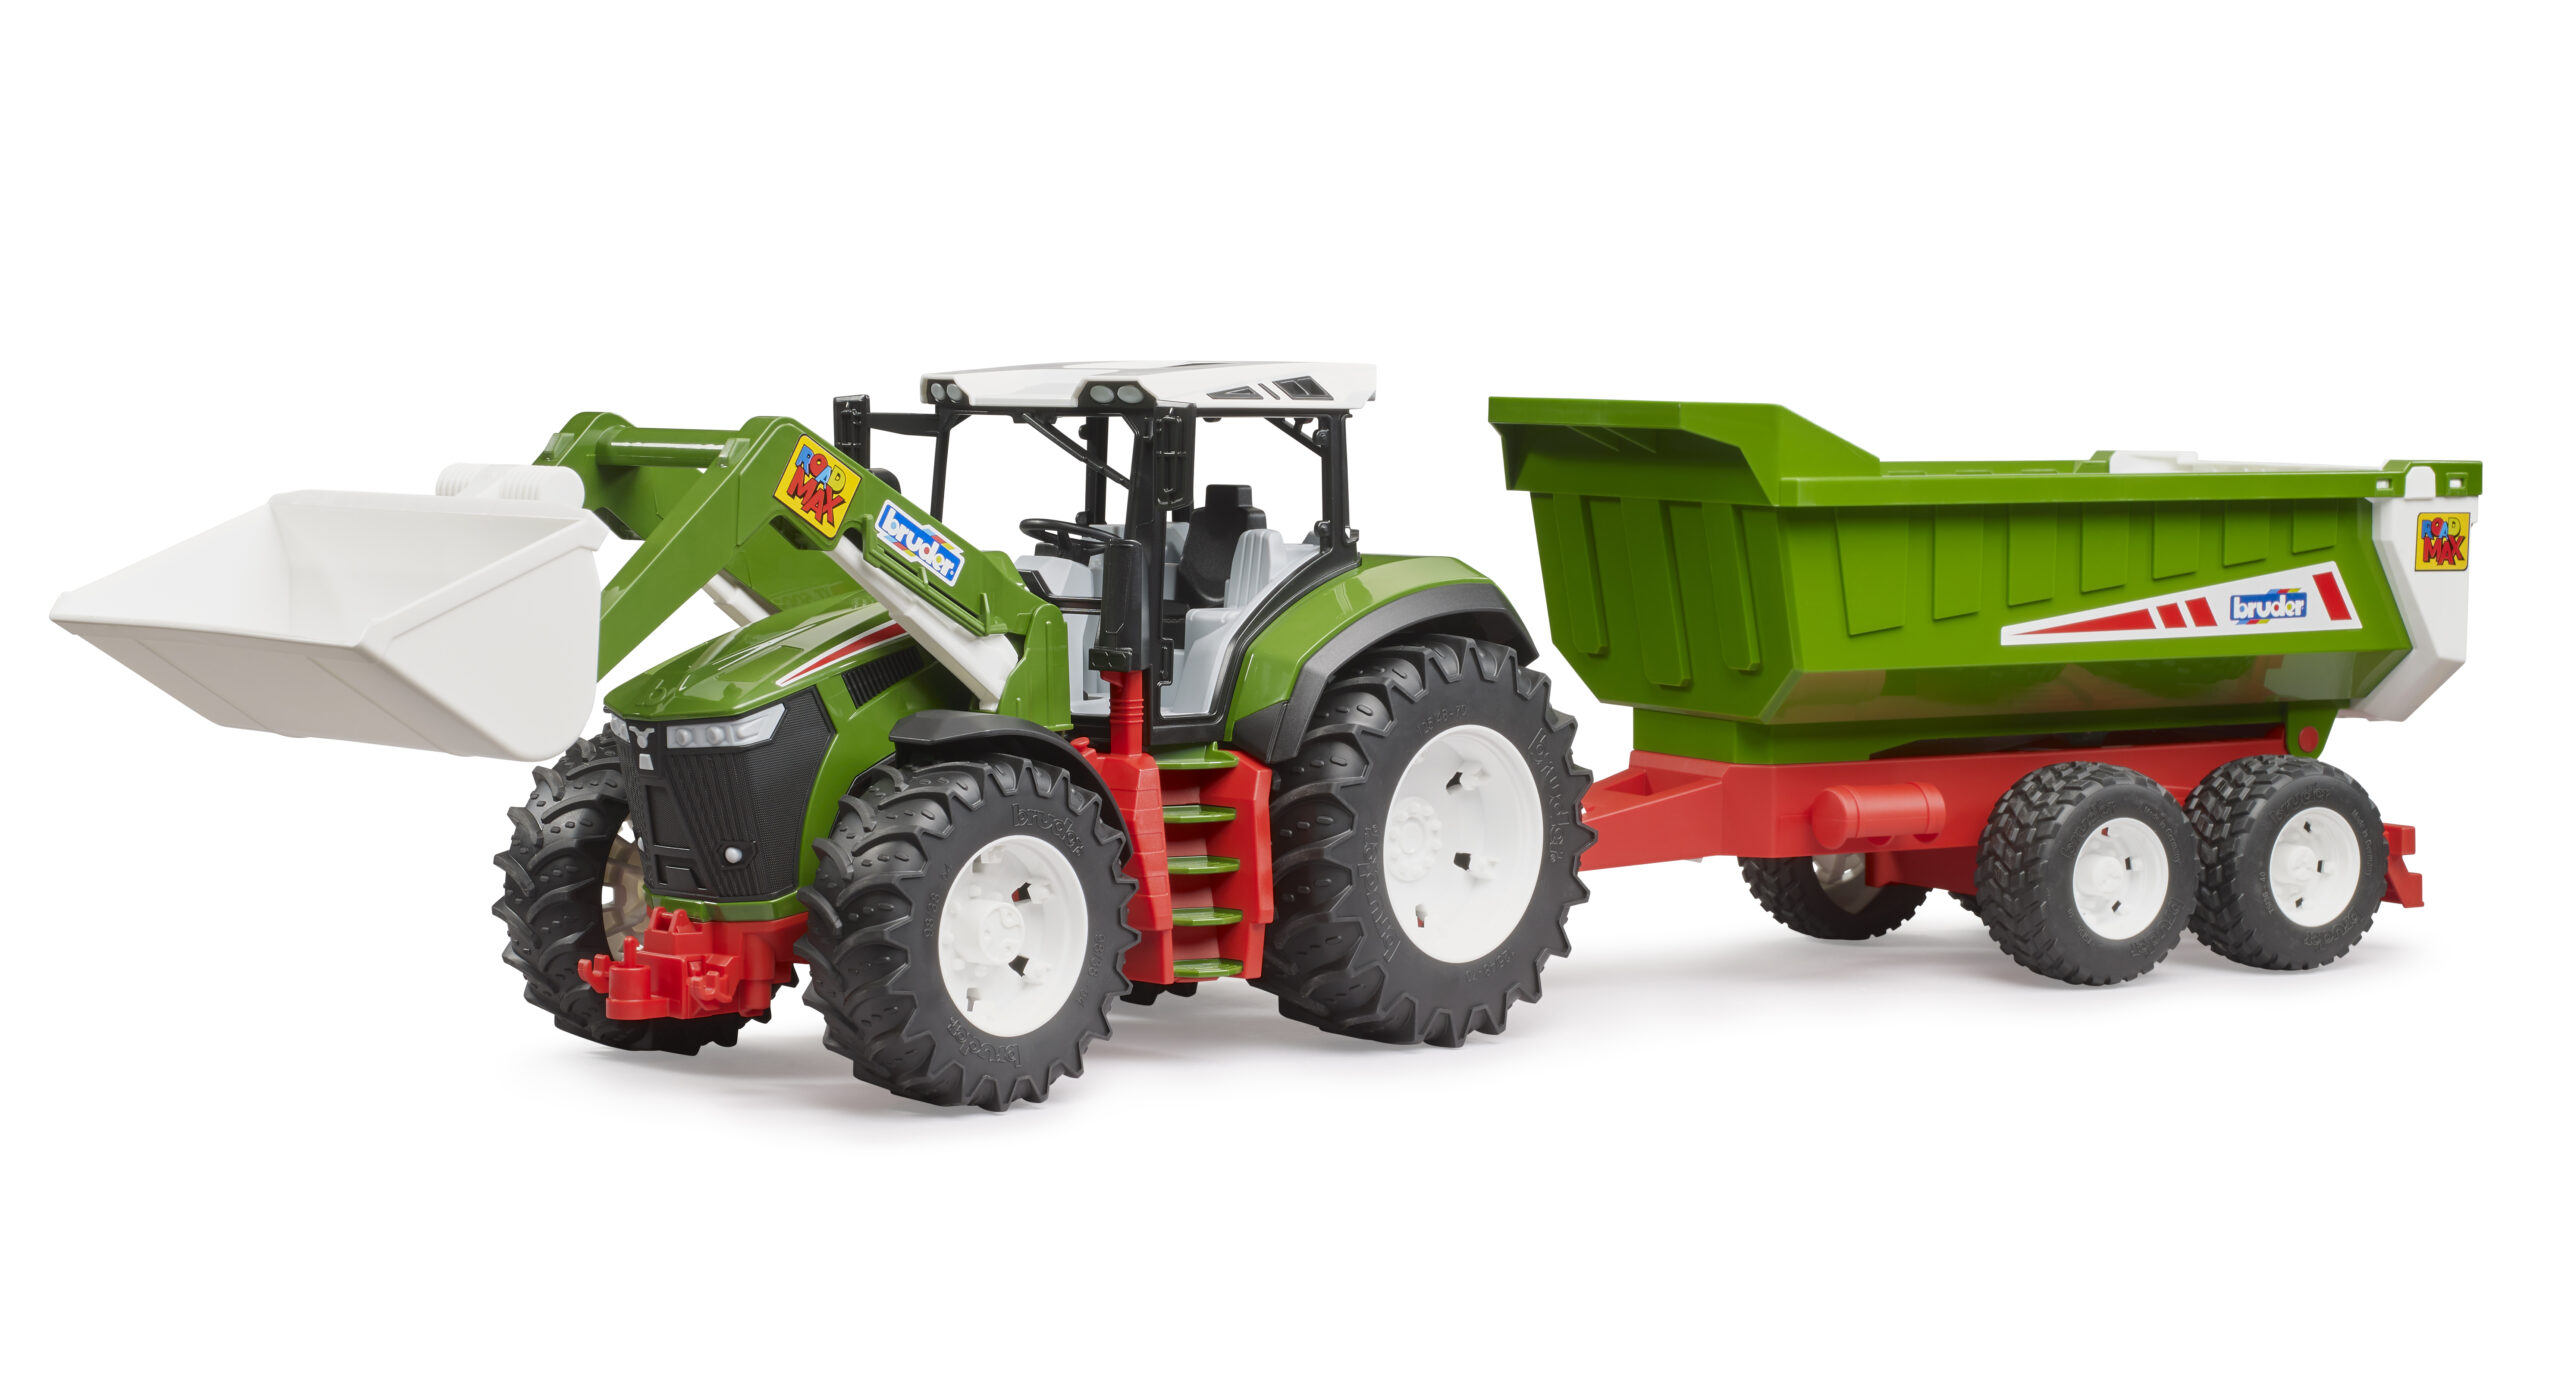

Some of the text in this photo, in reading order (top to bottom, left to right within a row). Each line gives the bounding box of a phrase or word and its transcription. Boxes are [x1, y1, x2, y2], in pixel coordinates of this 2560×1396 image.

[795, 444, 846, 494] ROAD
[786, 466, 846, 528] MAX
[881, 508, 955, 576] bruder
[2421, 517, 2461, 539] ROAD
[2423, 534, 2466, 565] MAX
[2233, 595, 2304, 620] bruder
[1011, 803, 1085, 857] bruder
